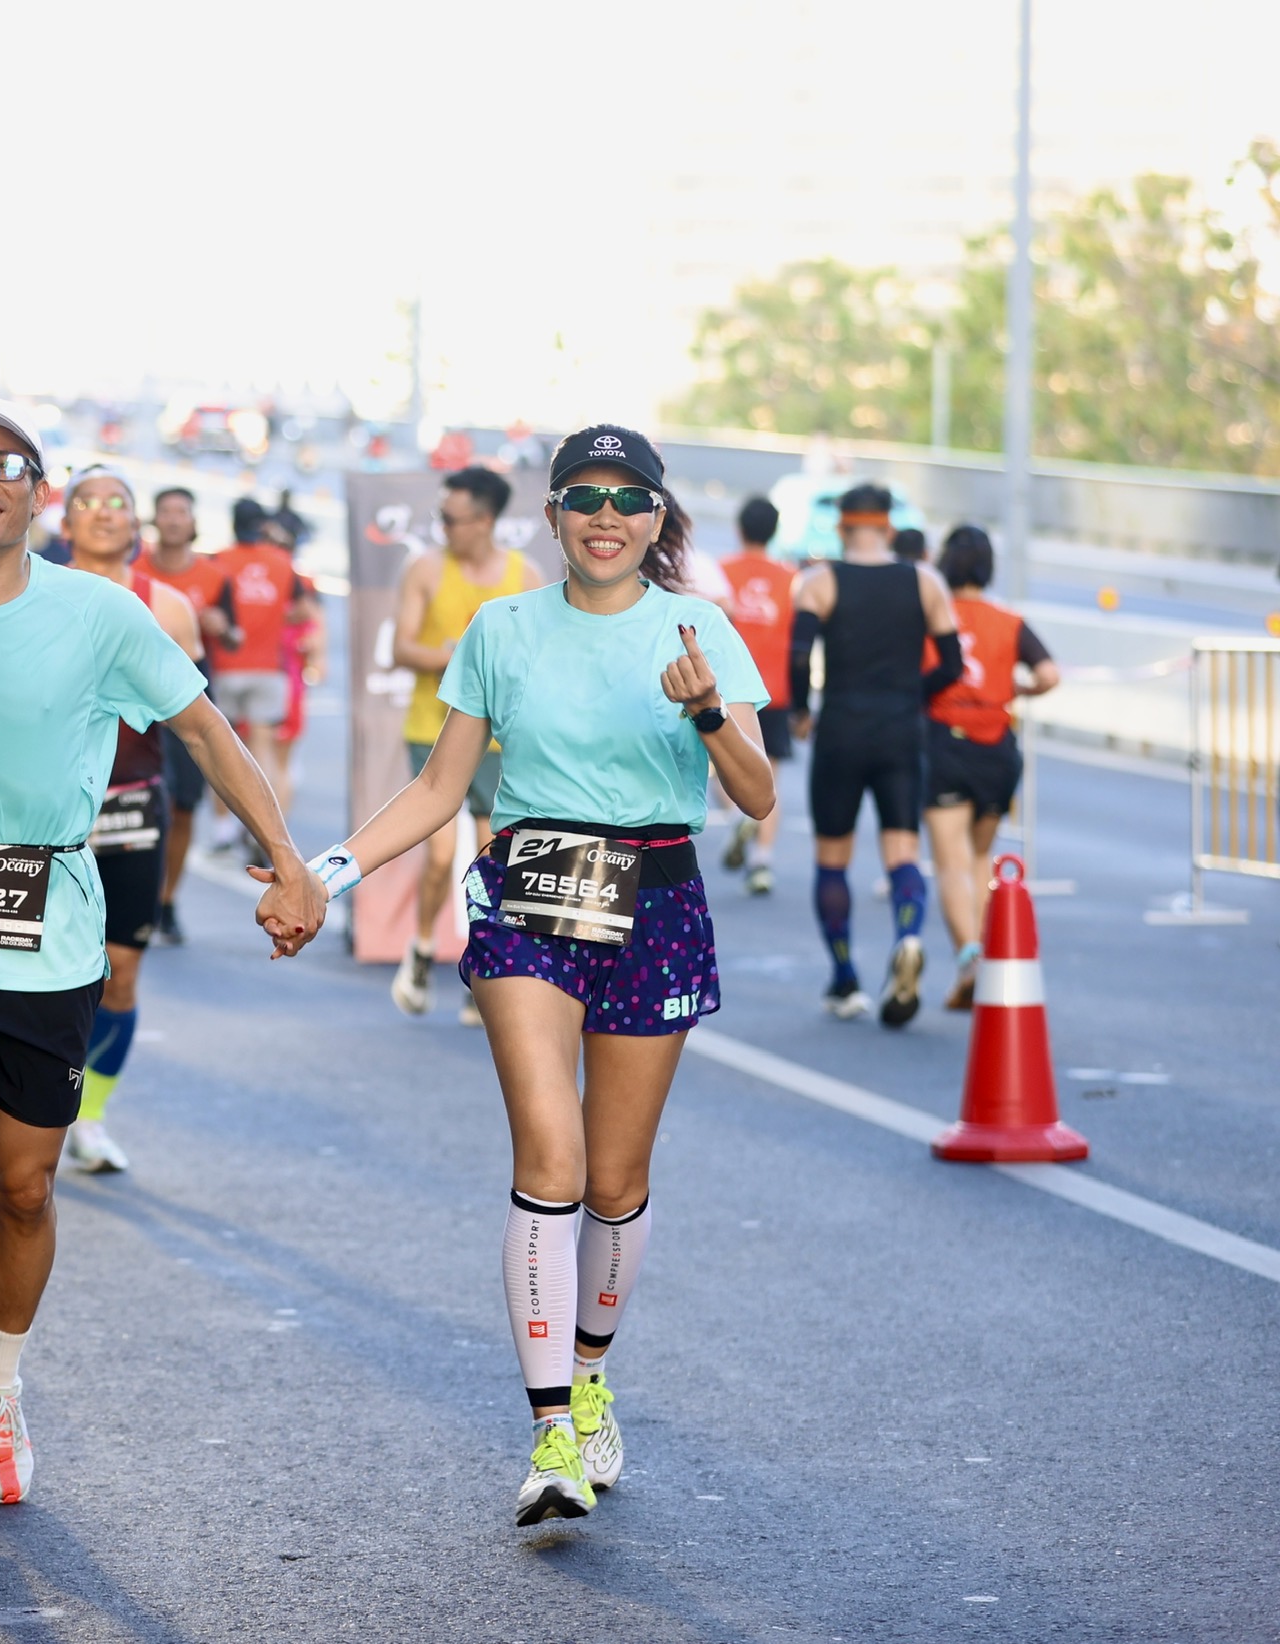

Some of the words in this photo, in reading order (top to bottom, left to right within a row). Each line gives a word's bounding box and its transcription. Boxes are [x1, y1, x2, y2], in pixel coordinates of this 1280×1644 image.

[588, 450, 626, 458] TOYOTA
[517, 838, 563, 857] 21
[587, 850, 636, 871] Ocany
[521, 871, 619, 902] 76564
[0, 935, 34, 943] RACEDAY
[528, 1218, 541, 1315] COMPRESSPORT
[606, 1226, 621, 1290] COMPRESSPORT
